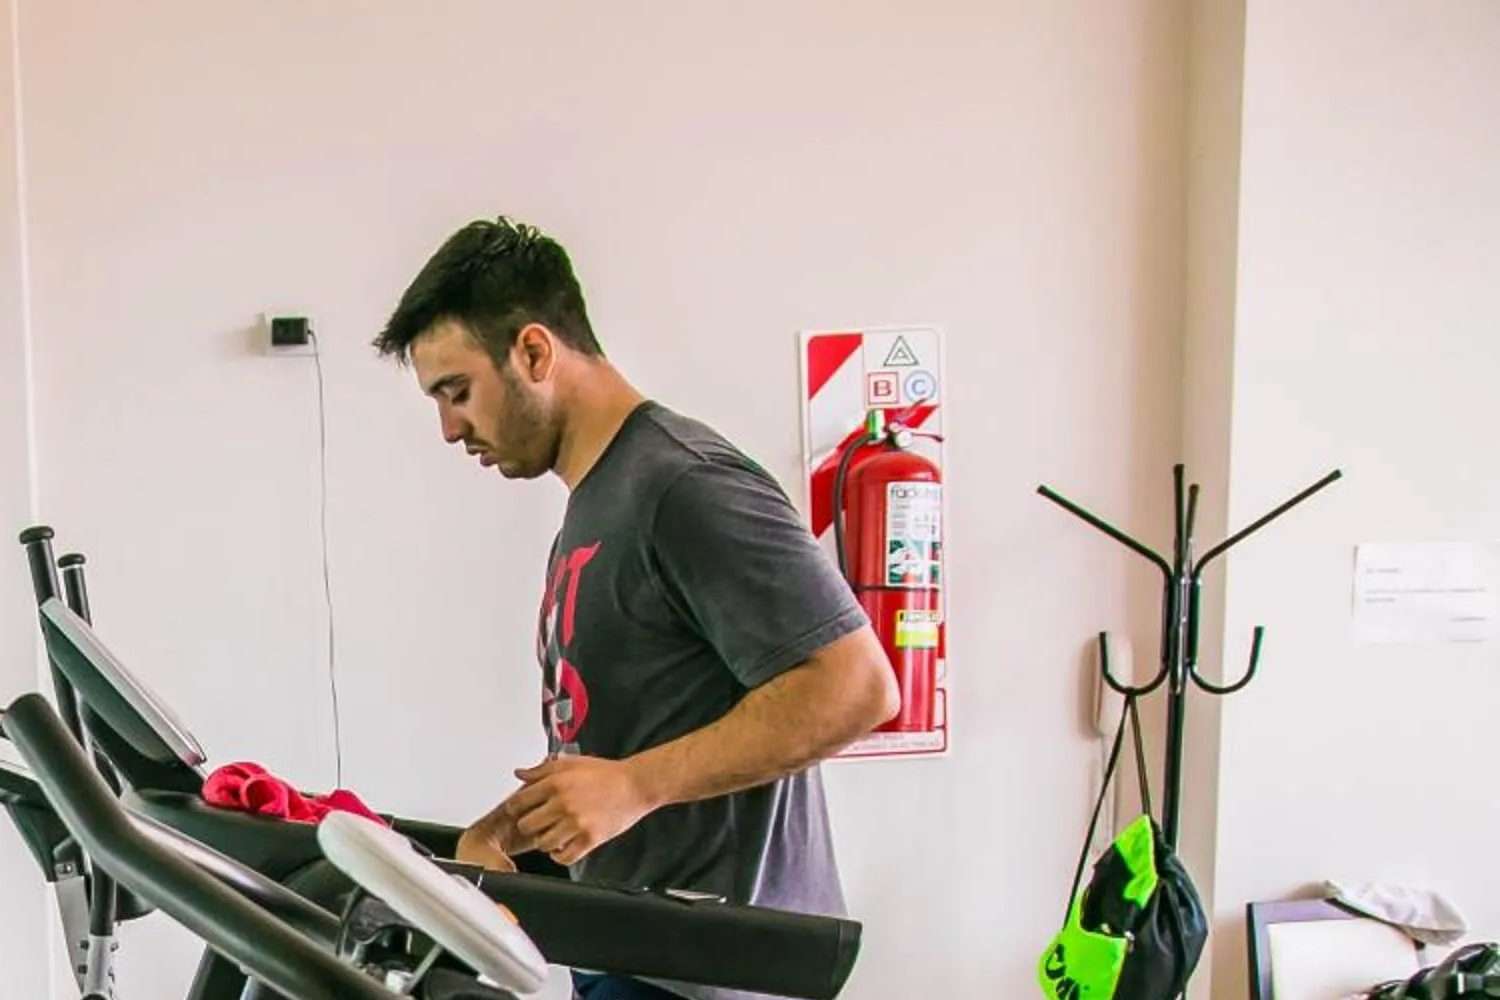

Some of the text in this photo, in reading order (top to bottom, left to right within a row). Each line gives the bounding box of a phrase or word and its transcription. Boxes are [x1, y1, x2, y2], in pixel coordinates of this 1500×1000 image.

[892, 347, 910, 361] A
[873, 379, 927, 397] B C
